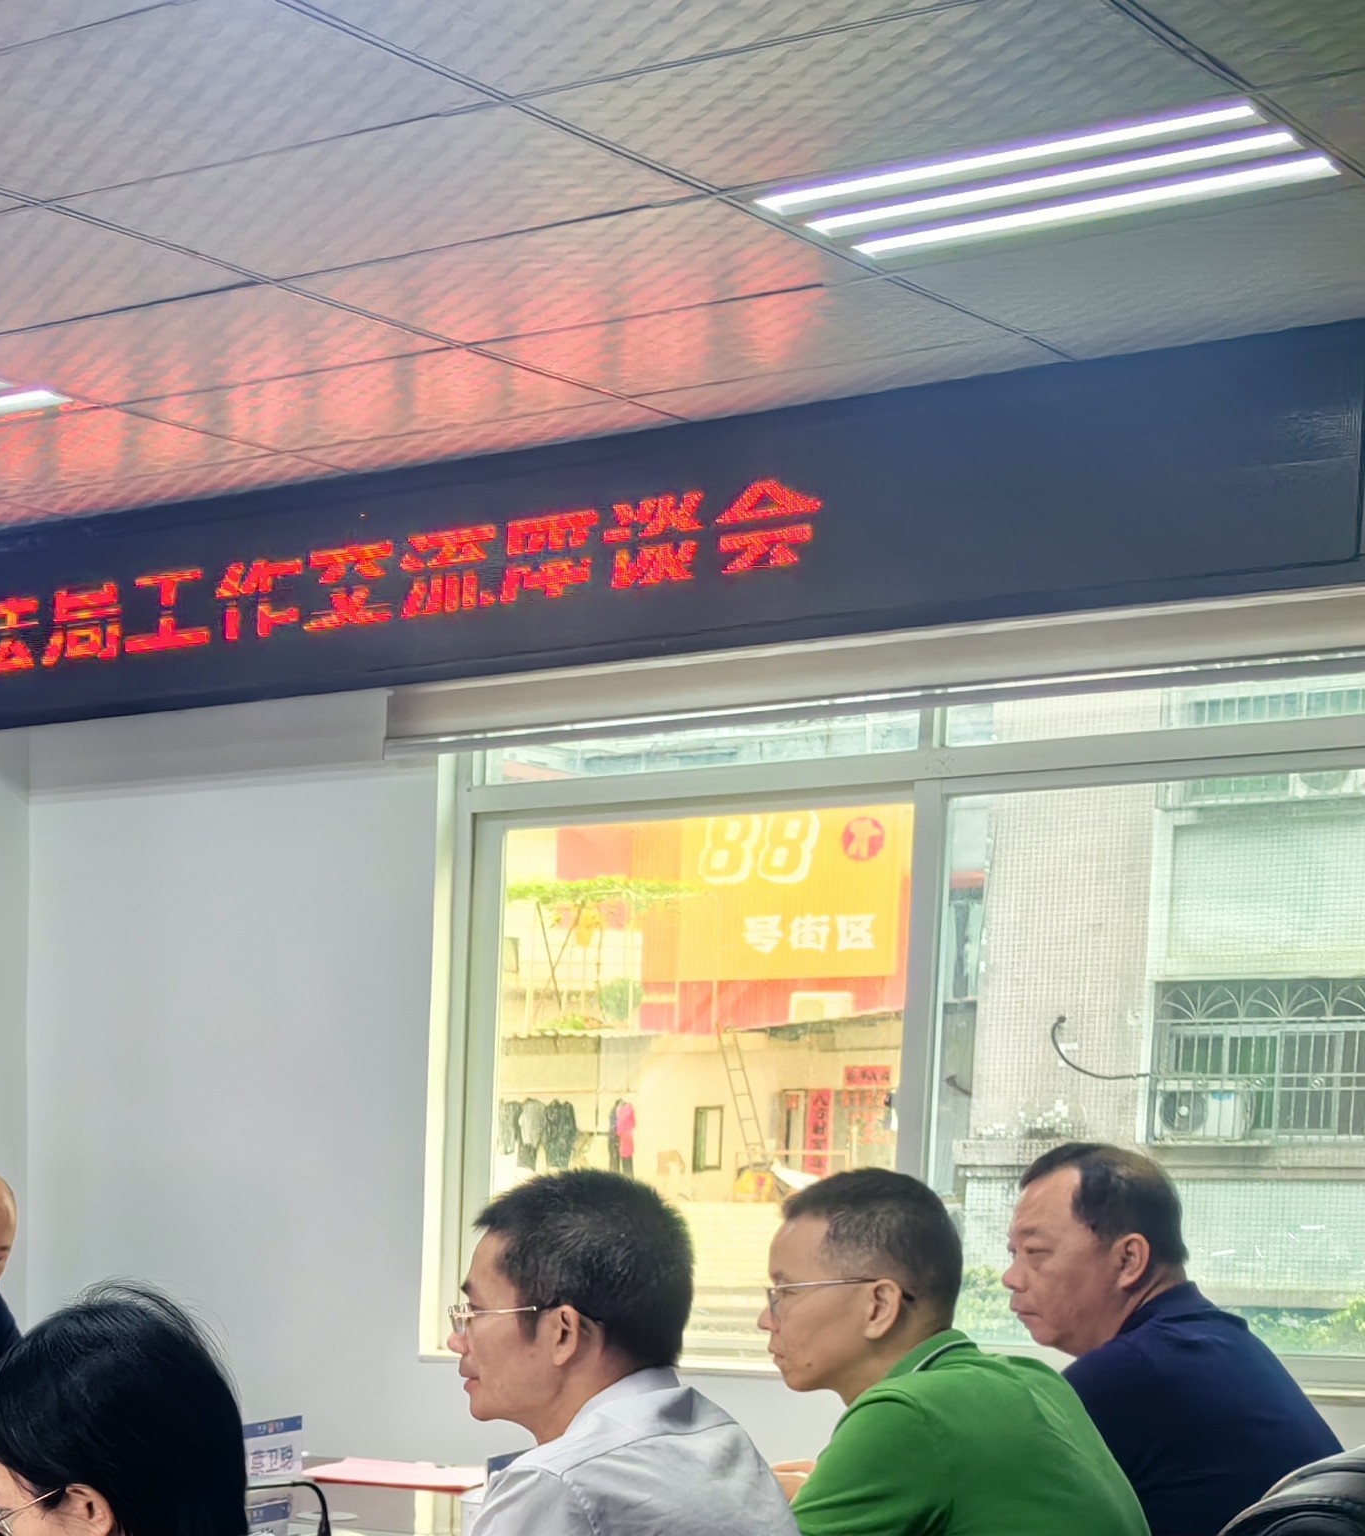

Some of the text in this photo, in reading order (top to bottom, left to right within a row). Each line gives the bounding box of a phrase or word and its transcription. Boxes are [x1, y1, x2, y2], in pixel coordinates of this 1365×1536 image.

[699, 810, 820, 885] 88
[741, 913, 878, 953] 号街区
